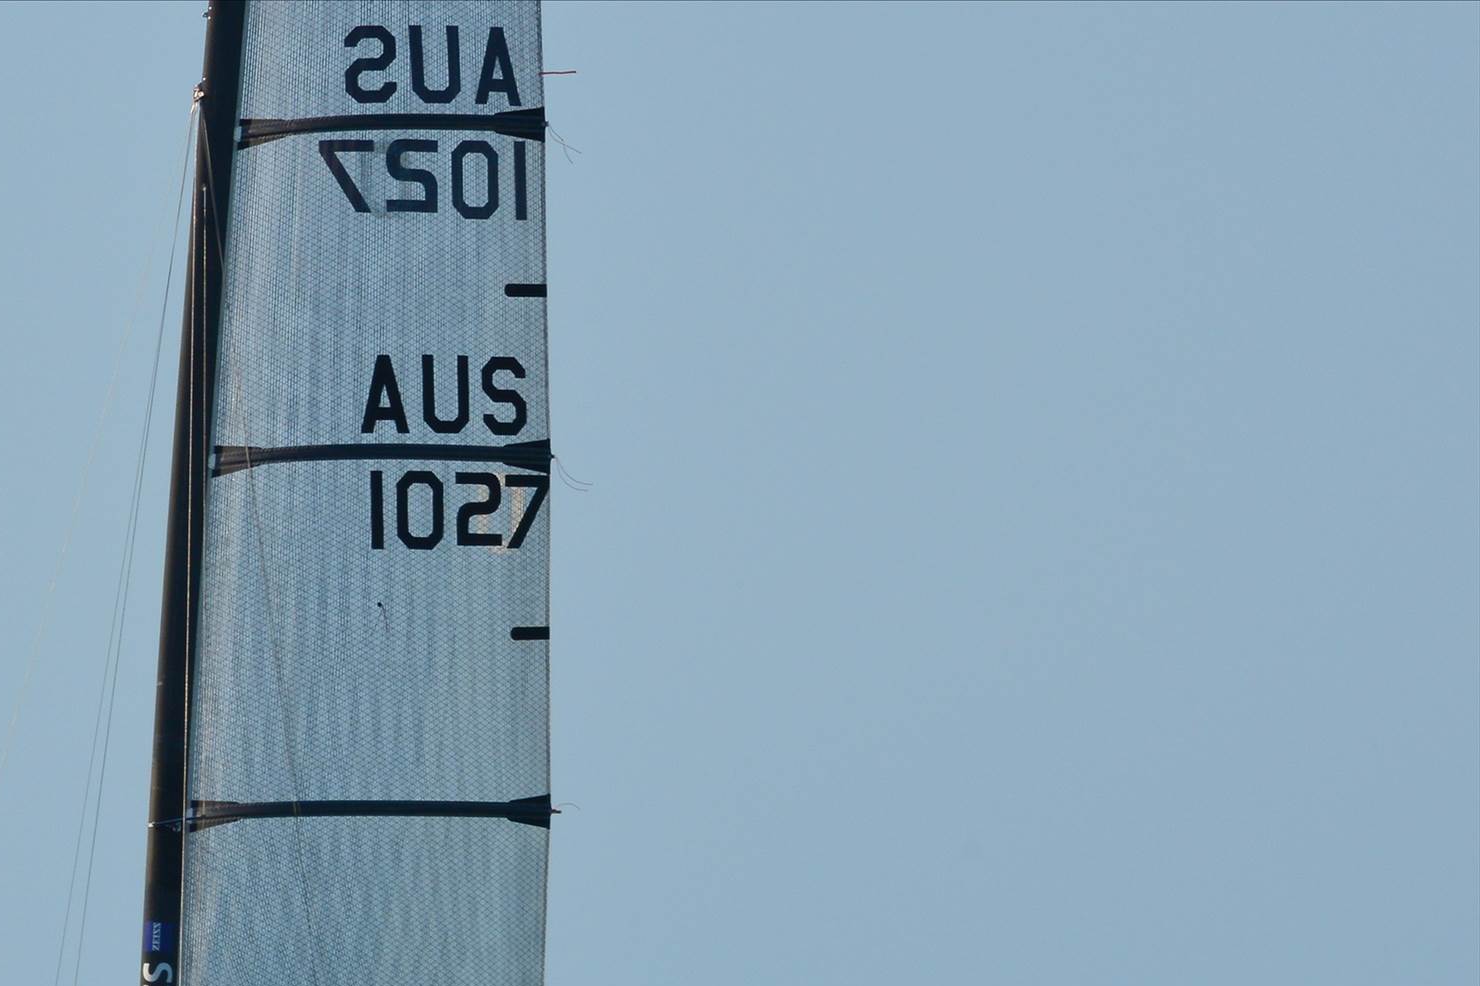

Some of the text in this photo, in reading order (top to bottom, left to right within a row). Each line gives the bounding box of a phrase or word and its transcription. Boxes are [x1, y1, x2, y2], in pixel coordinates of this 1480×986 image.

[361, 354, 527, 436] AUS
[370, 470, 550, 550] 1027
[151, 921, 161, 952] ZEISS
